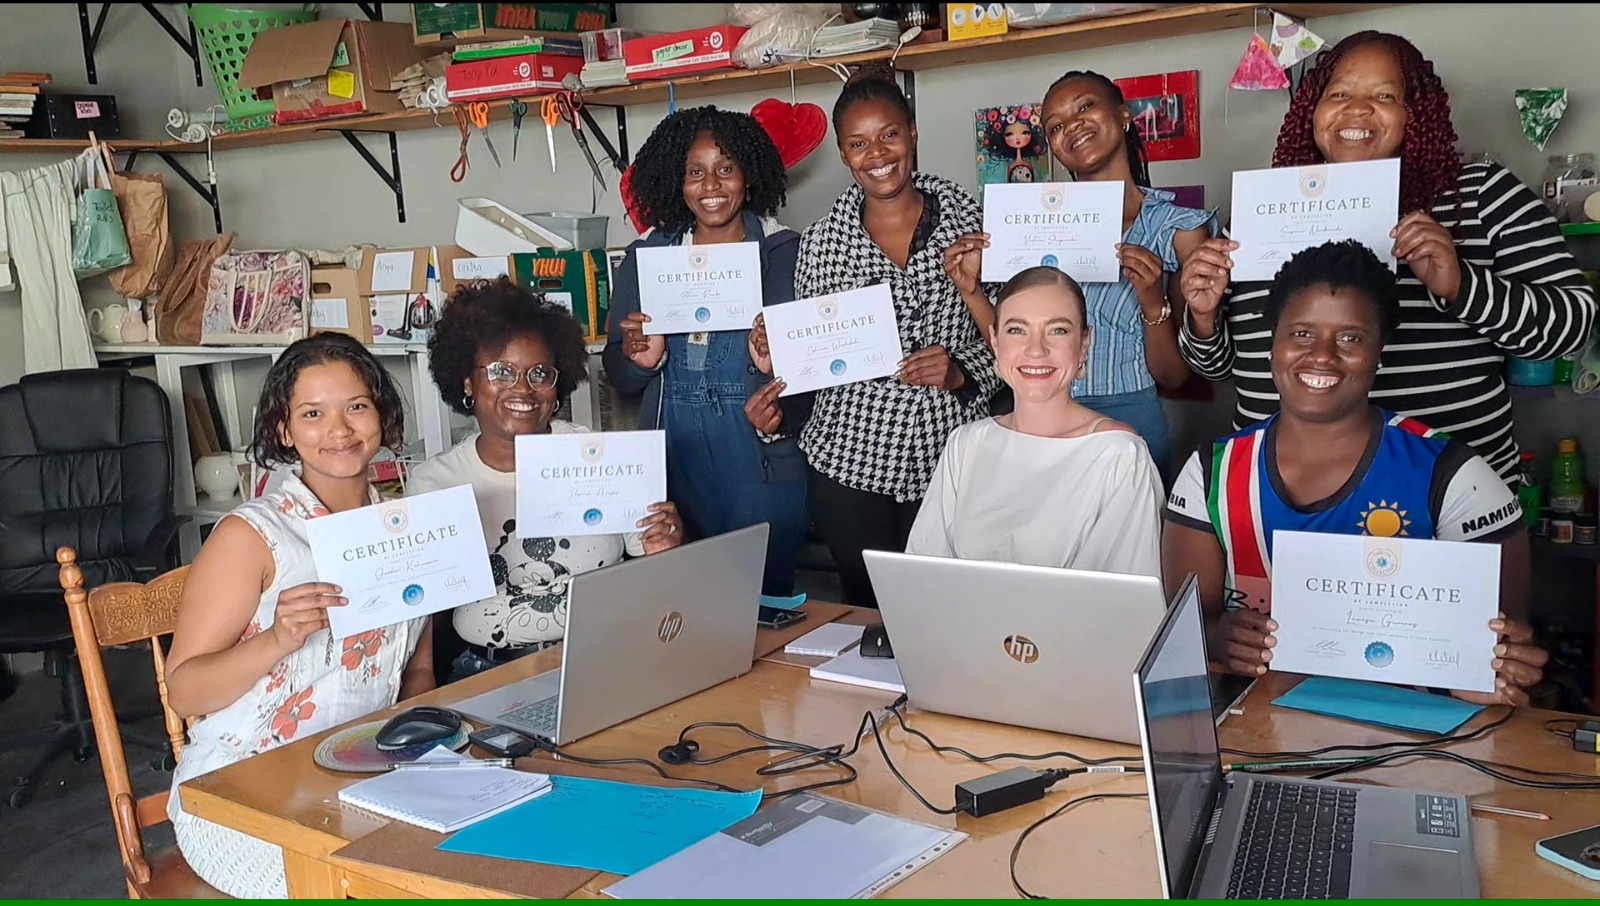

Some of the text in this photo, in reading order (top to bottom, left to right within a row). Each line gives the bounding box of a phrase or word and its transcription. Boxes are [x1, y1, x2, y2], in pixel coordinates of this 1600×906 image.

[1256, 197, 1372, 216] CERTIFICATE
[1004, 213, 1100, 225] CERTIFICATE
[532, 258, 567, 277] YHU!
[657, 270, 742, 283] CERTIFICATE
[787, 314, 876, 340] CERTIFICATE
[541, 464, 644, 479] CERTIFICATE
[343, 524, 459, 562] CERTIFICATE
[1305, 577, 1462, 604] CERTIFICATE
[660, 613, 682, 643] hp
[1010, 635, 1035, 663] hp
